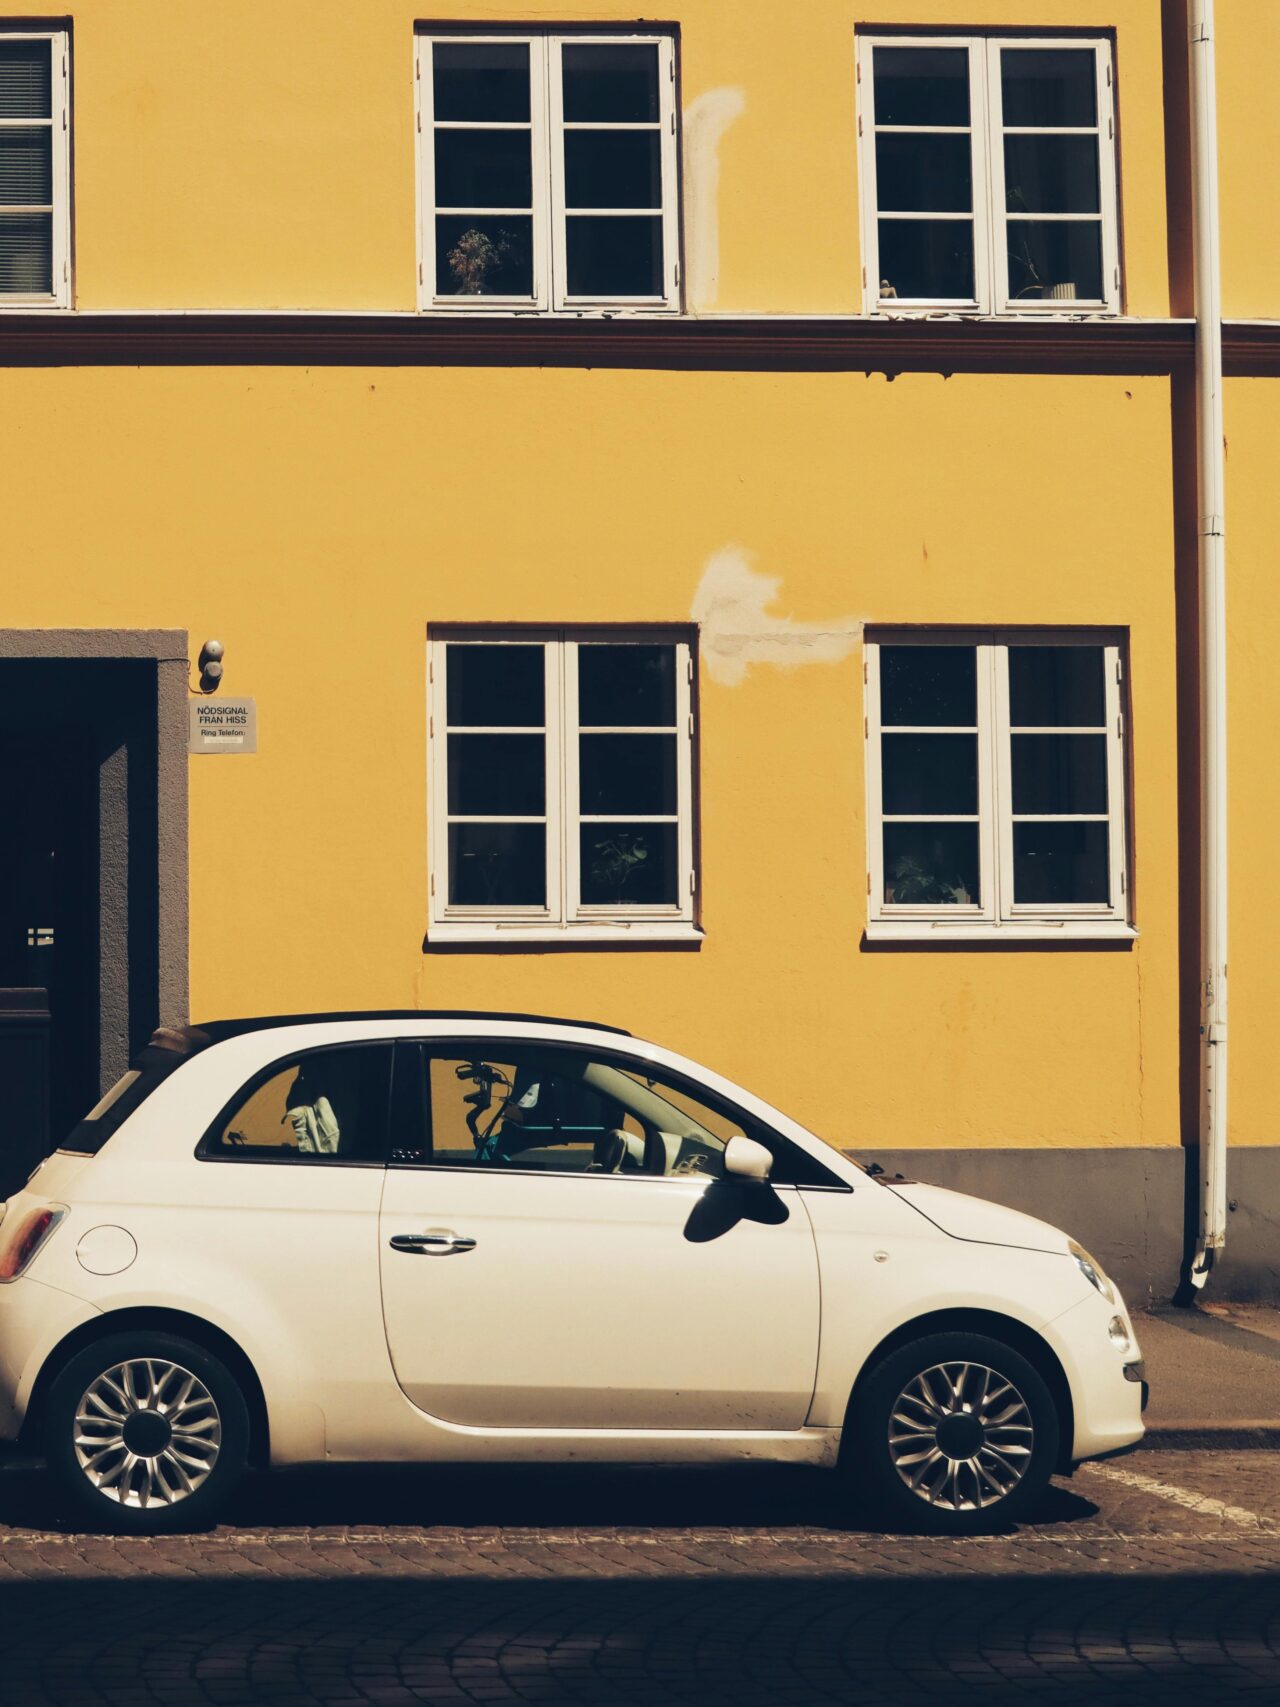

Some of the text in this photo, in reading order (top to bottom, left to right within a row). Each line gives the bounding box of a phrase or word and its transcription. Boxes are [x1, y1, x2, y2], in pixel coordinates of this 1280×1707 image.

[197, 705, 248, 715] NÖDSIGNAL
[199, 715, 247, 724] FRÅN HISS
[201, 729, 216, 737] Ring
